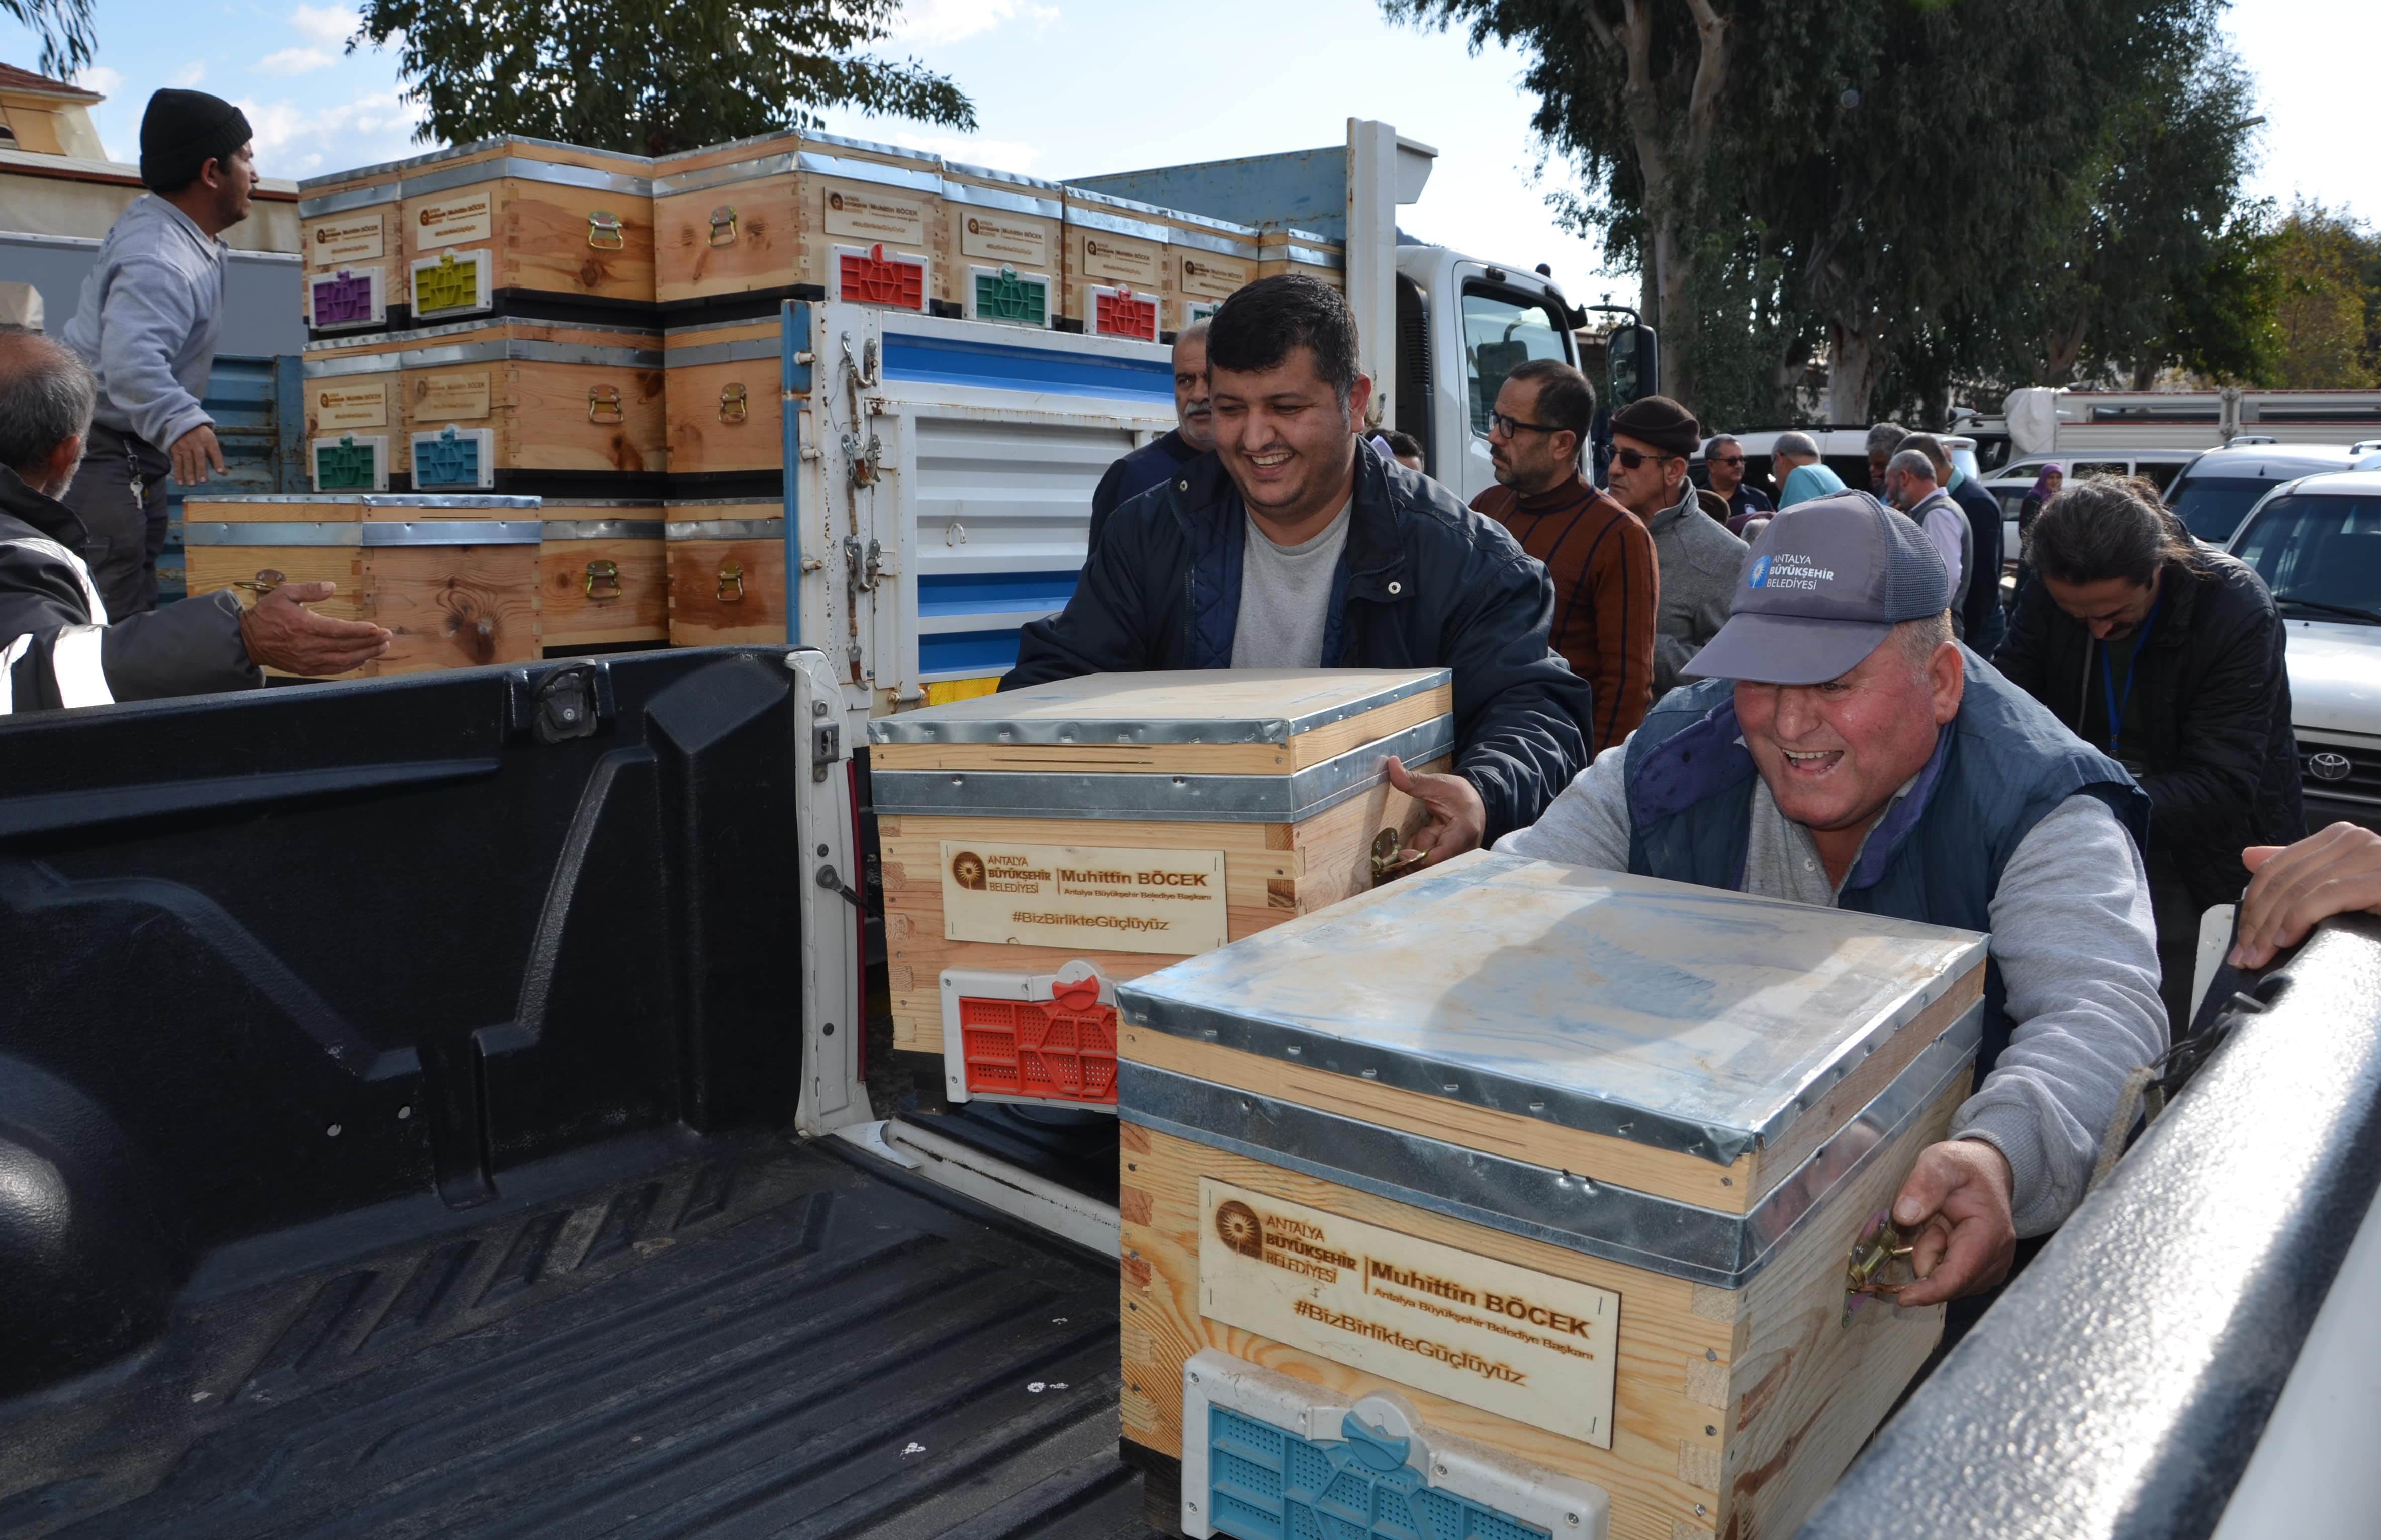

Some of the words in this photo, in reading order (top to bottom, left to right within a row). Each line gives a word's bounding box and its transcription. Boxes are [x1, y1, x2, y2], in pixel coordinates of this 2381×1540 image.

[870, 204, 894, 213] Muhittin
[896, 207, 918, 216] BÖCEK
[1773, 554, 1811, 565] ANTALYA
[1769, 564, 1834, 581] BÜYÜKŞEHİR
[1767, 578, 1817, 590] BELEDİYESİ
[988, 856, 1028, 867] ANTALYA
[988, 867, 1051, 882] BÜYÜKŞEHİR
[1061, 870, 1132, 884] Muhittin
[1137, 870, 1208, 886] BÖCEK
[989, 881, 1038, 893] BELEDİYESİ
[1095, 890, 1138, 898] Büyükşehir
[1012, 912, 1169, 932] #BizBirlikteGüçlüyüz
[1266, 1215, 1325, 1243] ANTALYA
[1266, 1233, 1356, 1271] BÜYÜKŞEHİR
[1267, 1252, 1337, 1284] BELEDİYESİ
[1371, 1260, 1476, 1306] Muhittin
[1485, 1293, 1590, 1339] BÖCEK
[1374, 1288, 1415, 1307] Antalya
[1419, 1301, 1484, 1327] Büyükşehir
[1487, 1321, 1539, 1345] Belediye
[1543, 1337, 1594, 1361] Başkanı
[1294, 1299, 1528, 1387] #BizBirlikteGüçlüyüz
